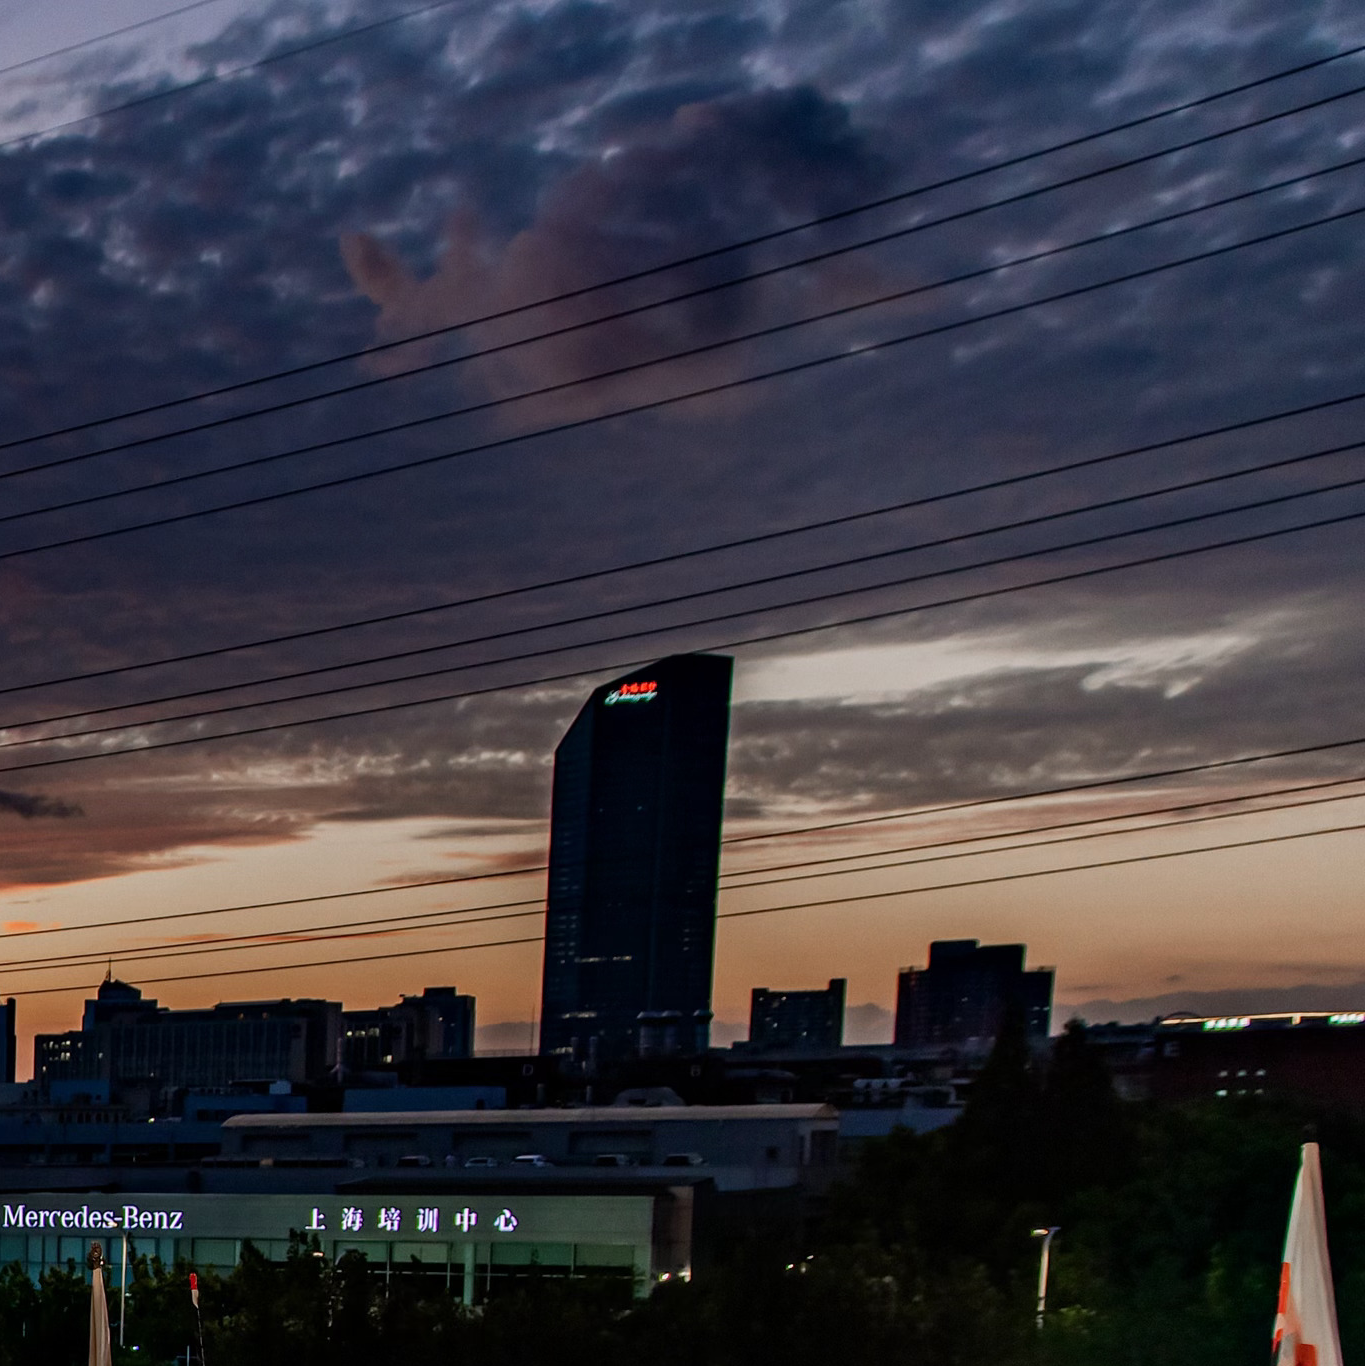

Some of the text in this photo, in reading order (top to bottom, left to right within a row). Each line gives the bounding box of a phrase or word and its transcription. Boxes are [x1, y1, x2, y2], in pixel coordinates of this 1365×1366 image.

[2, 1204, 183, 1230] Mercedes-Benz
[305, 1207, 519, 1232] 上海培训中心
